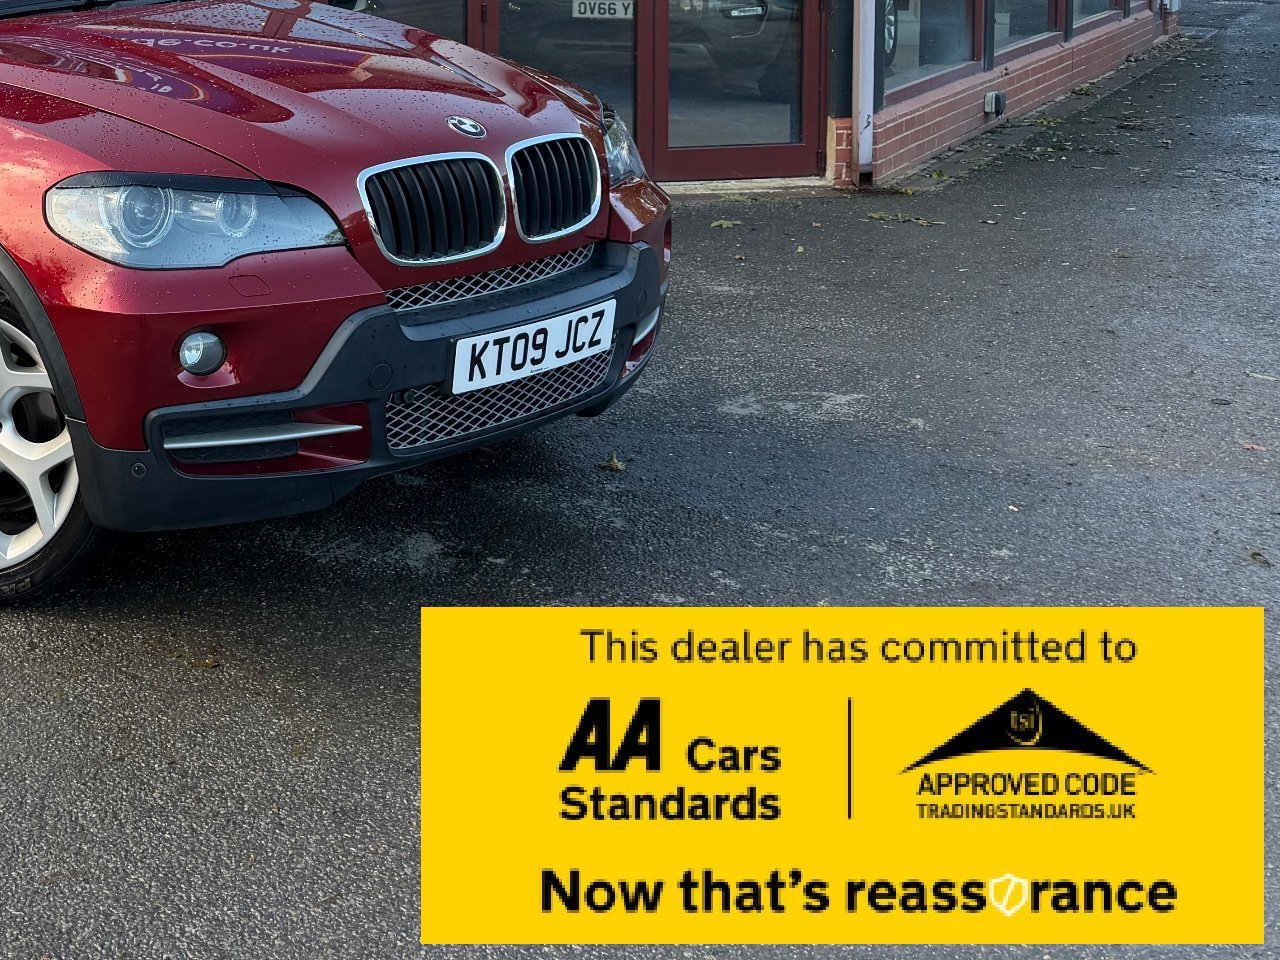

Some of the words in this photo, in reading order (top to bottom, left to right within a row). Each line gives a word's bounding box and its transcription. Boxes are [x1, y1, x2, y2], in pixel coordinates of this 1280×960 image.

[578, 1, 617, 16] OV66
[468, 327, 549, 383] KT09
[555, 308, 606, 359] JCZ
